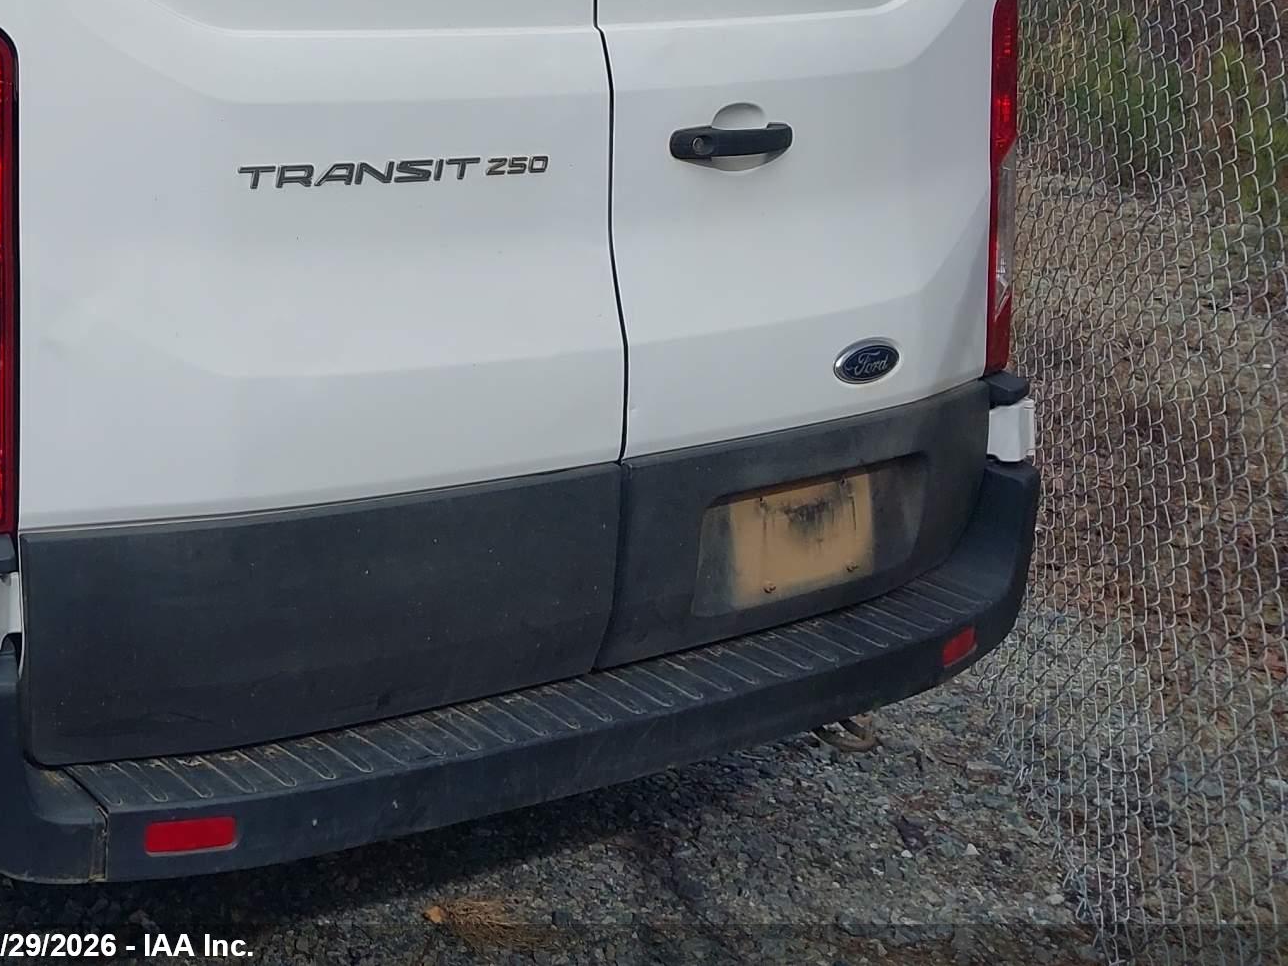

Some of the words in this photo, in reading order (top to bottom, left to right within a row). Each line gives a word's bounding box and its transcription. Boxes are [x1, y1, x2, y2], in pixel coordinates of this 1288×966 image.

[237, 156, 481, 190] TRANSIT
[486, 155, 549, 176] 250
[848, 349, 889, 376] Ford
